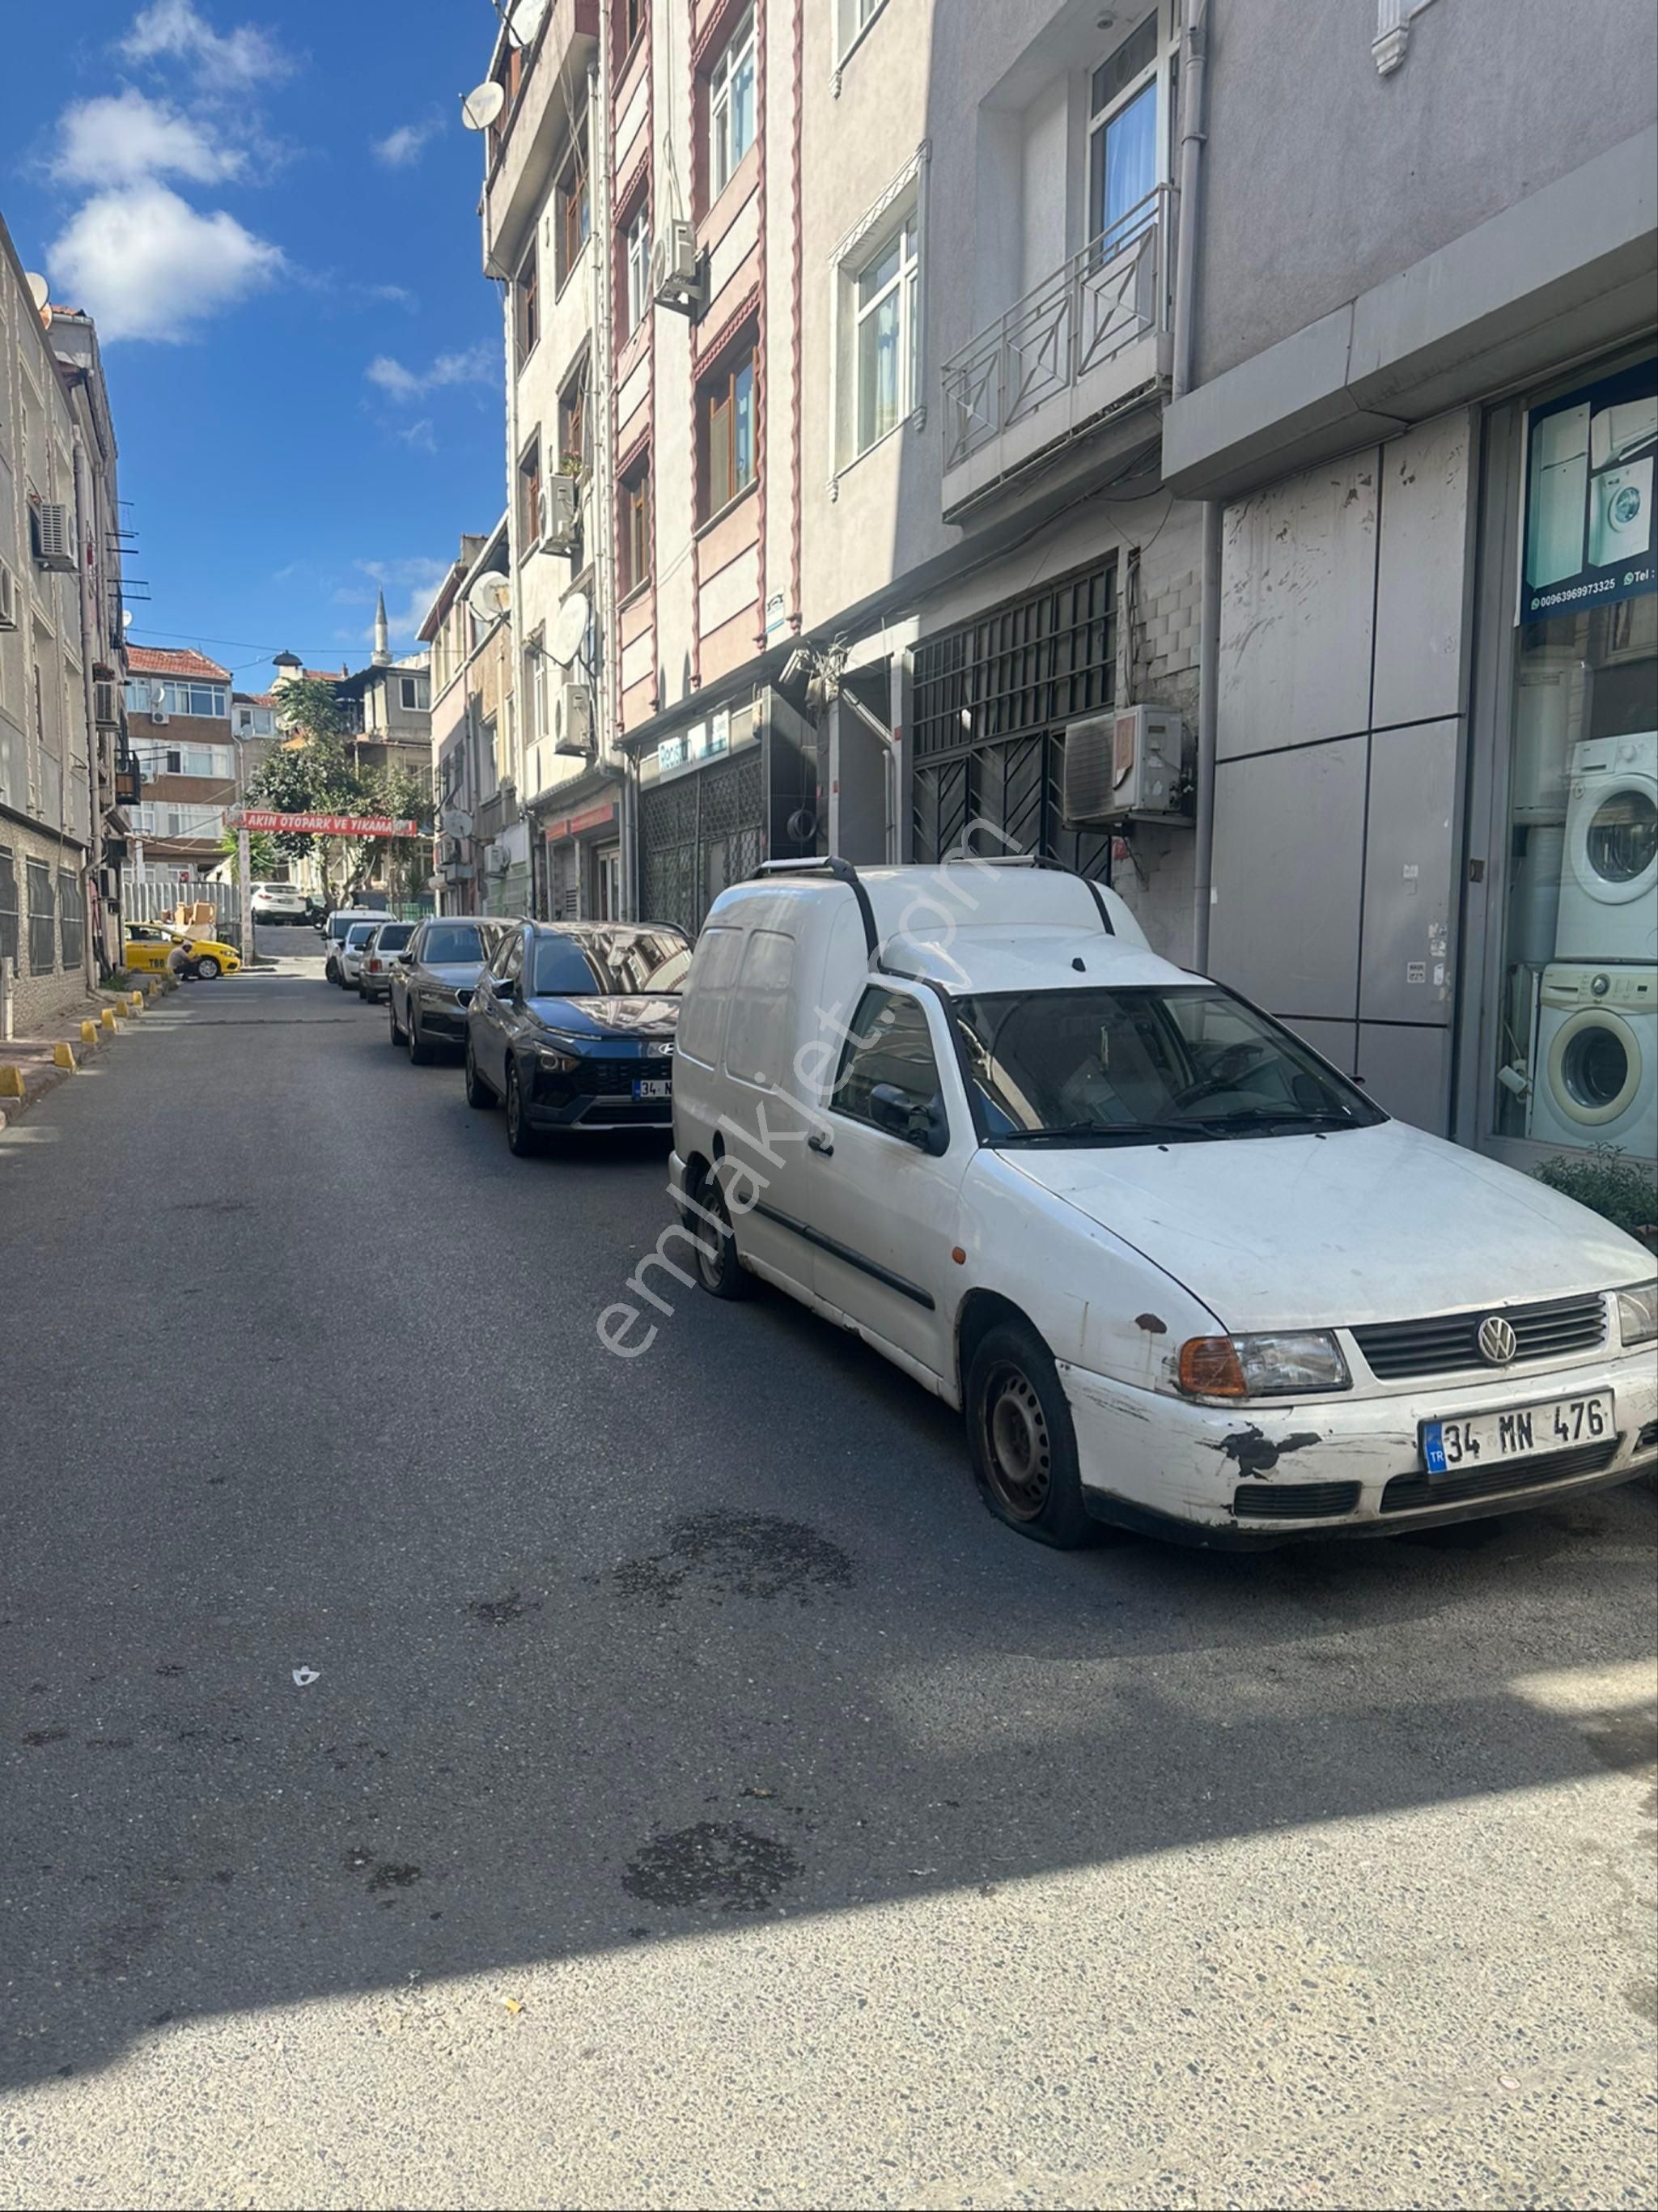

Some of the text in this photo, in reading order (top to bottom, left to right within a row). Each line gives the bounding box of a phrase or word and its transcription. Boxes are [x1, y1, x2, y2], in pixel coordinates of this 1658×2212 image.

[1635, 569, 1649, 582] Tel
[1541, 578, 1616, 607] 00963969973325
[280, 817, 332, 829] OTOPARK
[333, 819, 347, 830] VE
[642, 1081, 656, 1095] 34
[1444, 1399, 1604, 1463] 34 MN 476
[1430, 1450, 1444, 1463] TR
